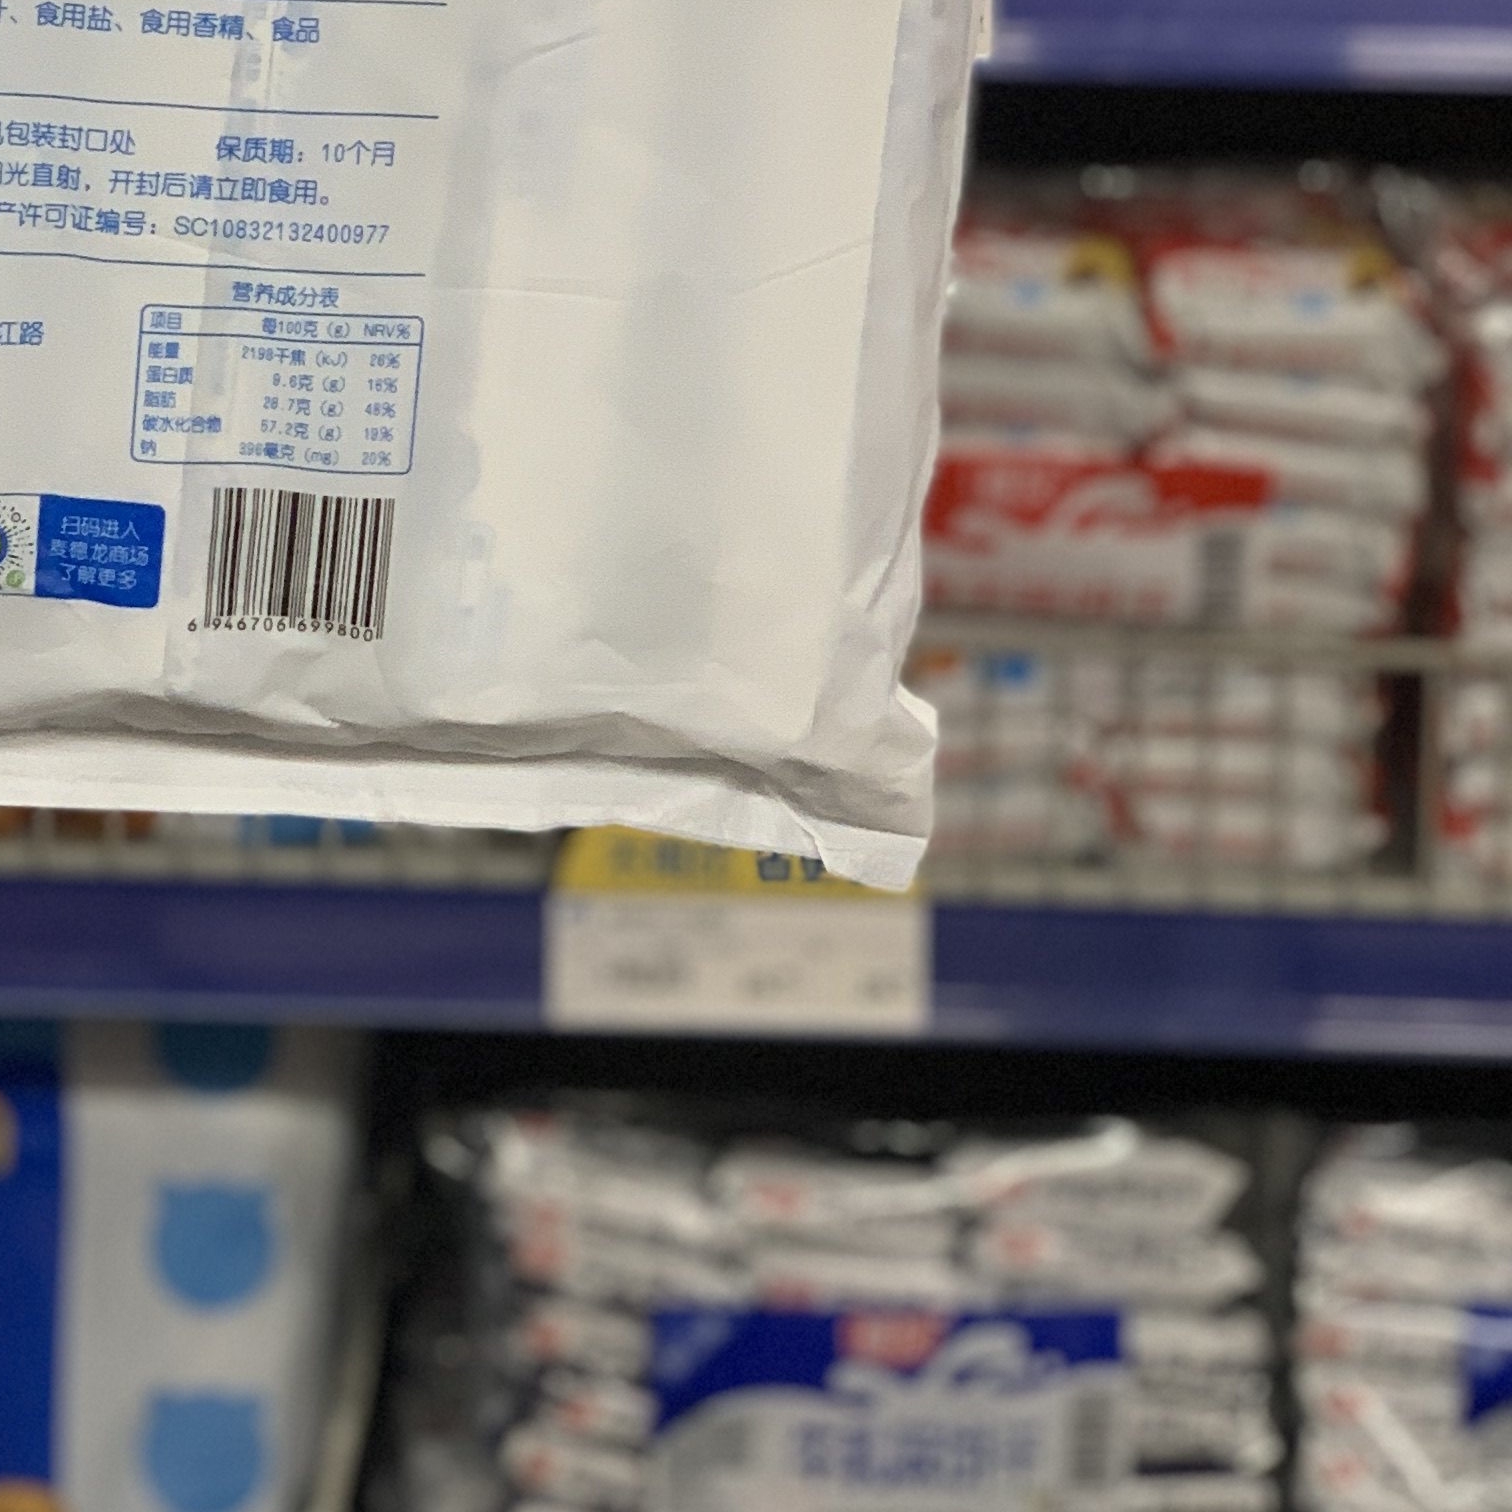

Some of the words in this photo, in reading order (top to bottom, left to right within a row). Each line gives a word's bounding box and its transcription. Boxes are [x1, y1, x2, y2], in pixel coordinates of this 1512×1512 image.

[232, 281, 340, 309] 营养成分表
[150, 311, 182, 331] 项目
[363, 322, 412, 340] NRV%
[147, 341, 180, 360] 能量
[145, 366, 194, 385] 蛋白质
[143, 390, 178, 409] 脂肪
[60, 514, 142, 542] 扫码进入
[49, 538, 150, 567] 麦德龙商场
[59, 562, 137, 591] 了解更多
